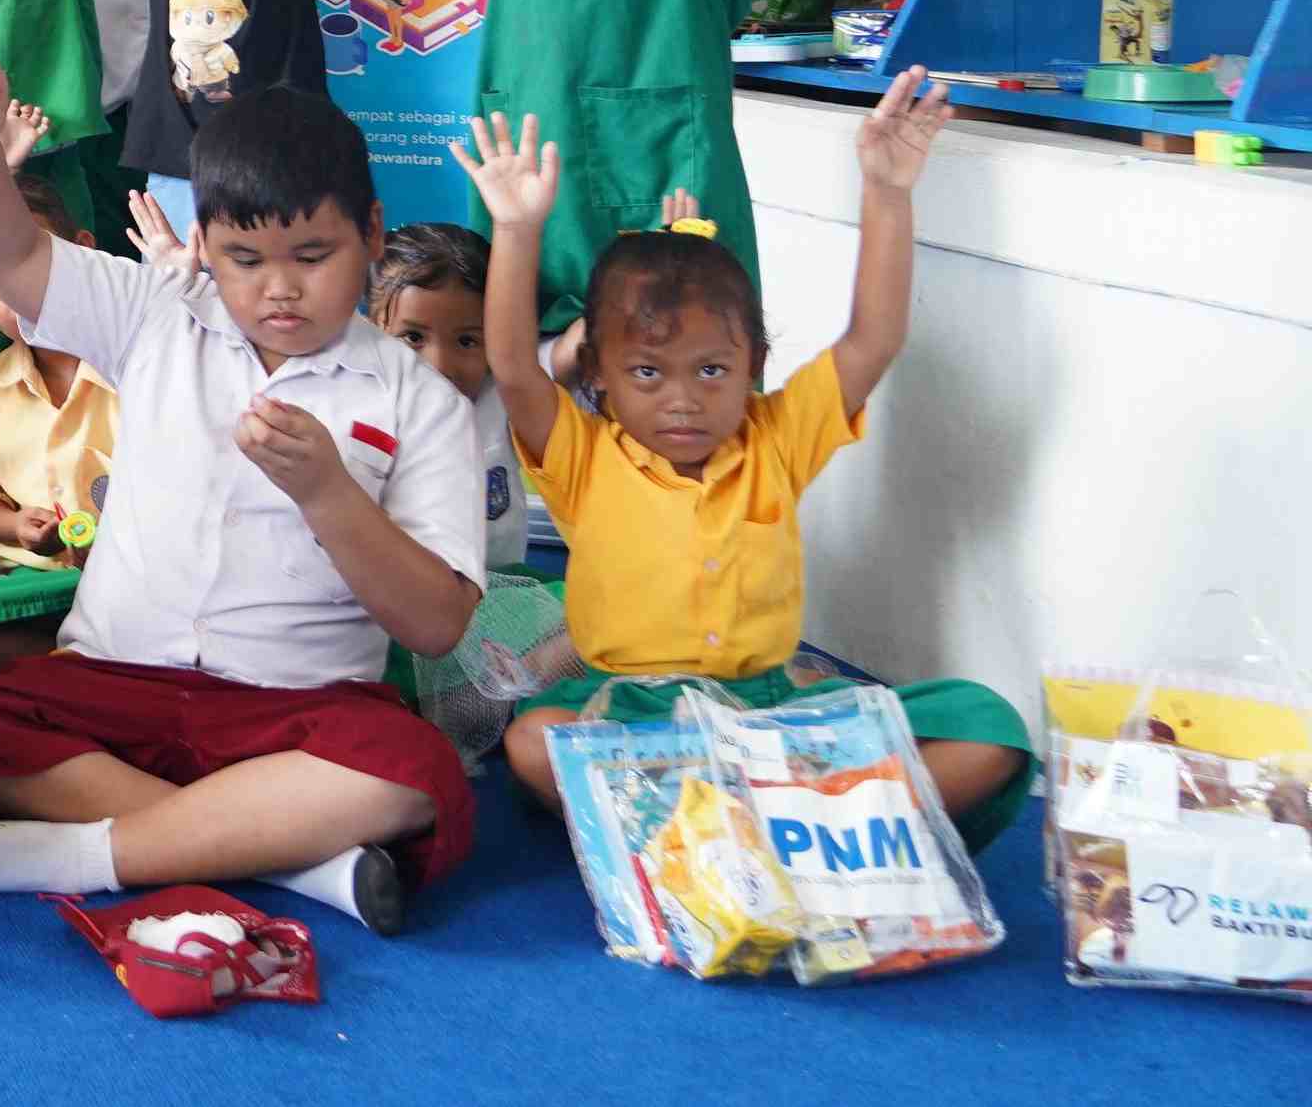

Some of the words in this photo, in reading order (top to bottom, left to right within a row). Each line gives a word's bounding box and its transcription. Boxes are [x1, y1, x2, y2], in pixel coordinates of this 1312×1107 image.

[346, 109, 394, 124] empat
[398, 110, 456, 127] sebagai
[366, 132, 407, 146] orang
[411, 131, 469, 147] sebagai
[767, 816, 923, 874] PNM
[1211, 915, 1279, 938] BAKTI
